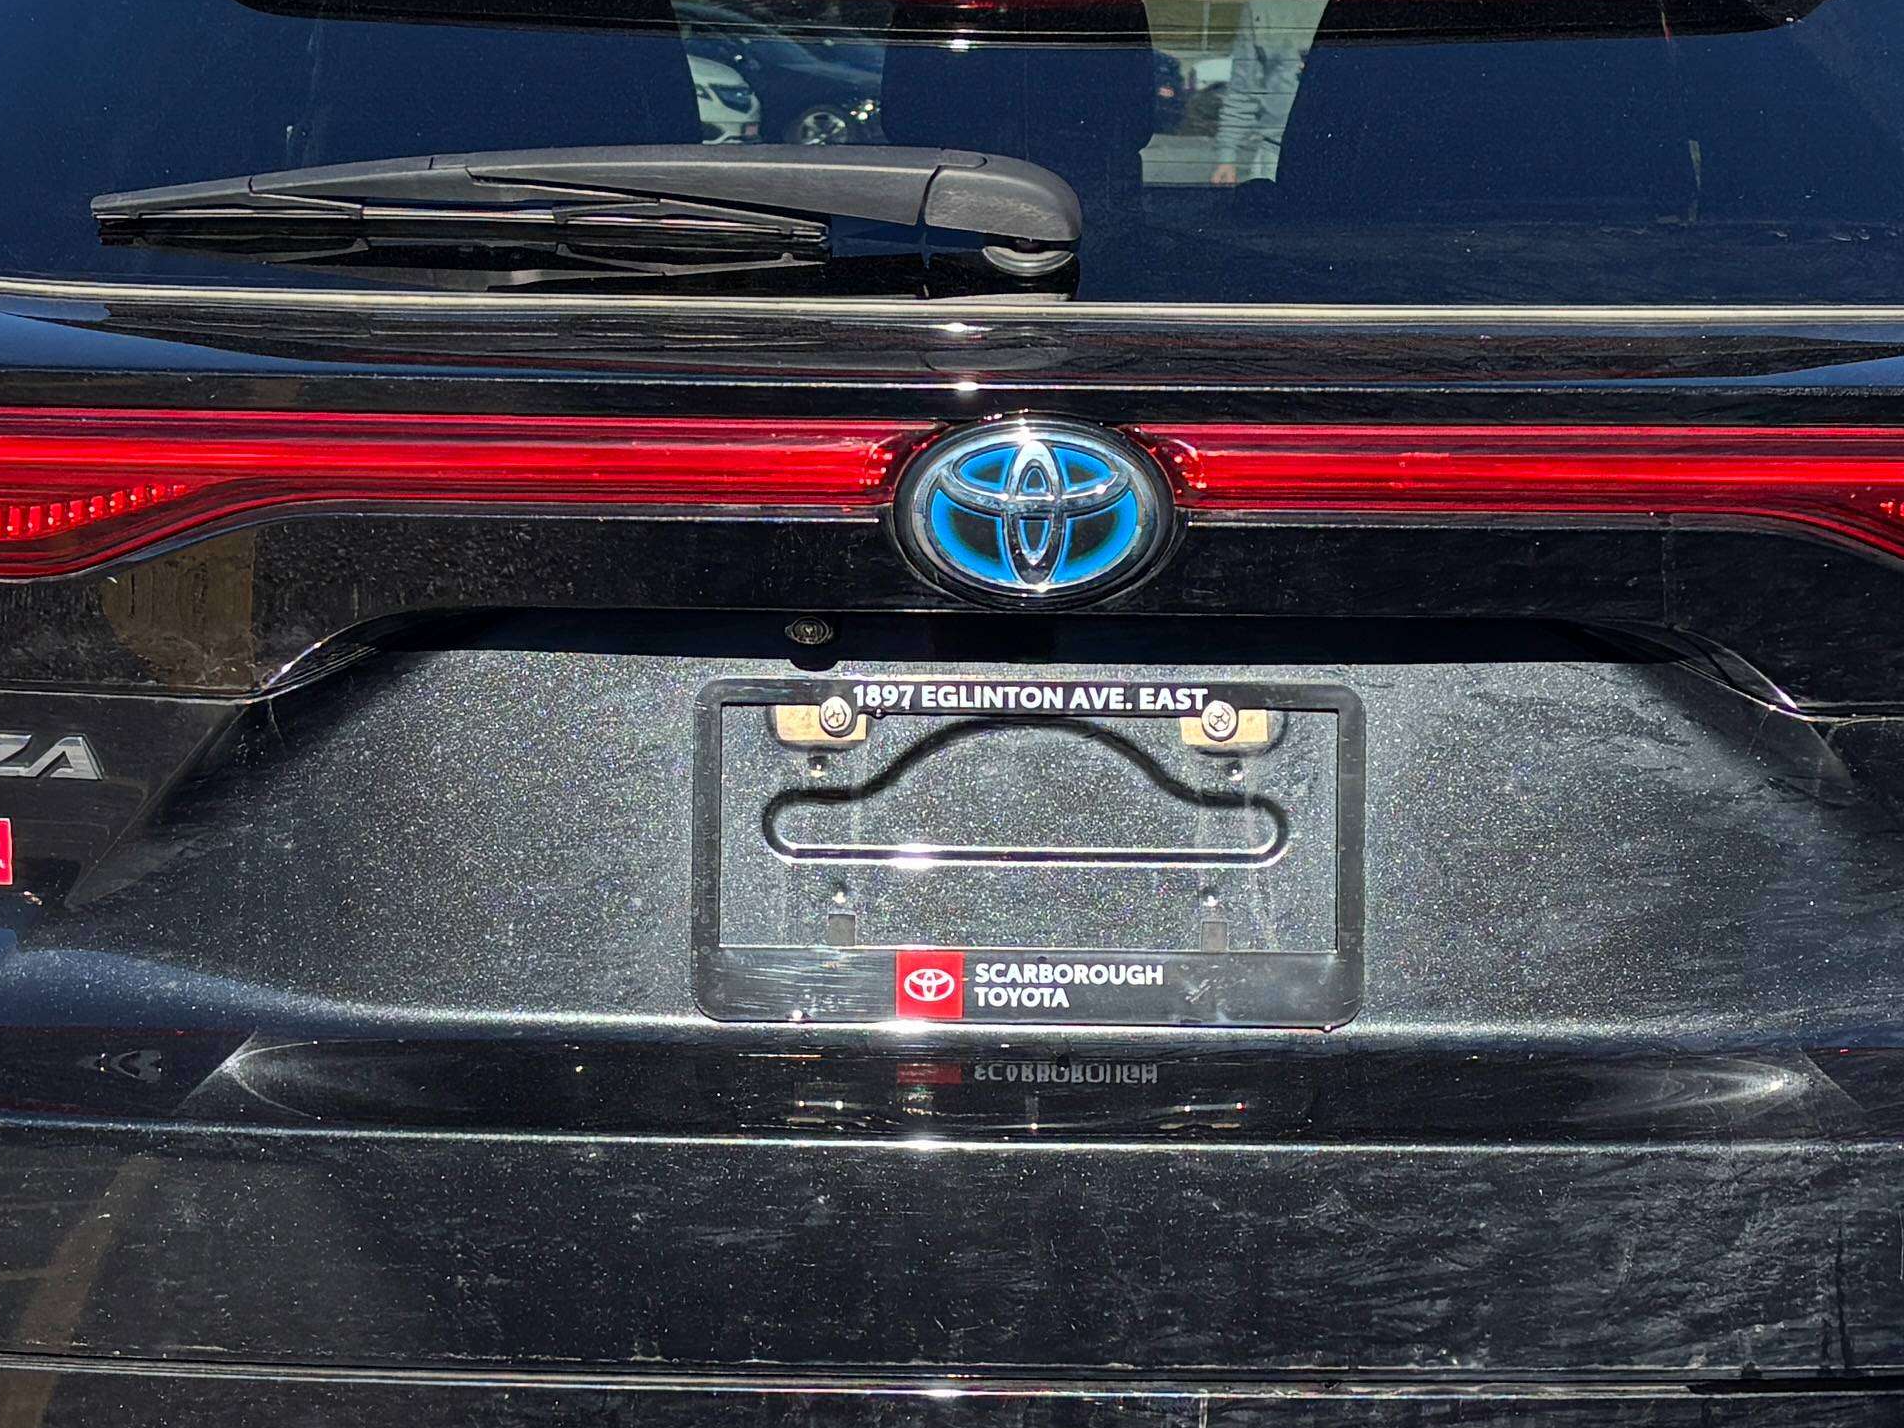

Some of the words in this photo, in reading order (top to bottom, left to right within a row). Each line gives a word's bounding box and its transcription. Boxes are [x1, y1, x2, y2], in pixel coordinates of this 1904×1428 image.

[853, 684, 914, 710] 1897
[921, 686, 1064, 710] EGLINTON
[1069, 686, 1133, 710] AVE.
[1138, 687, 1209, 710] EAST
[974, 962, 1165, 986] SCARBOROUGH
[973, 986, 1071, 1009] TOYOTA
